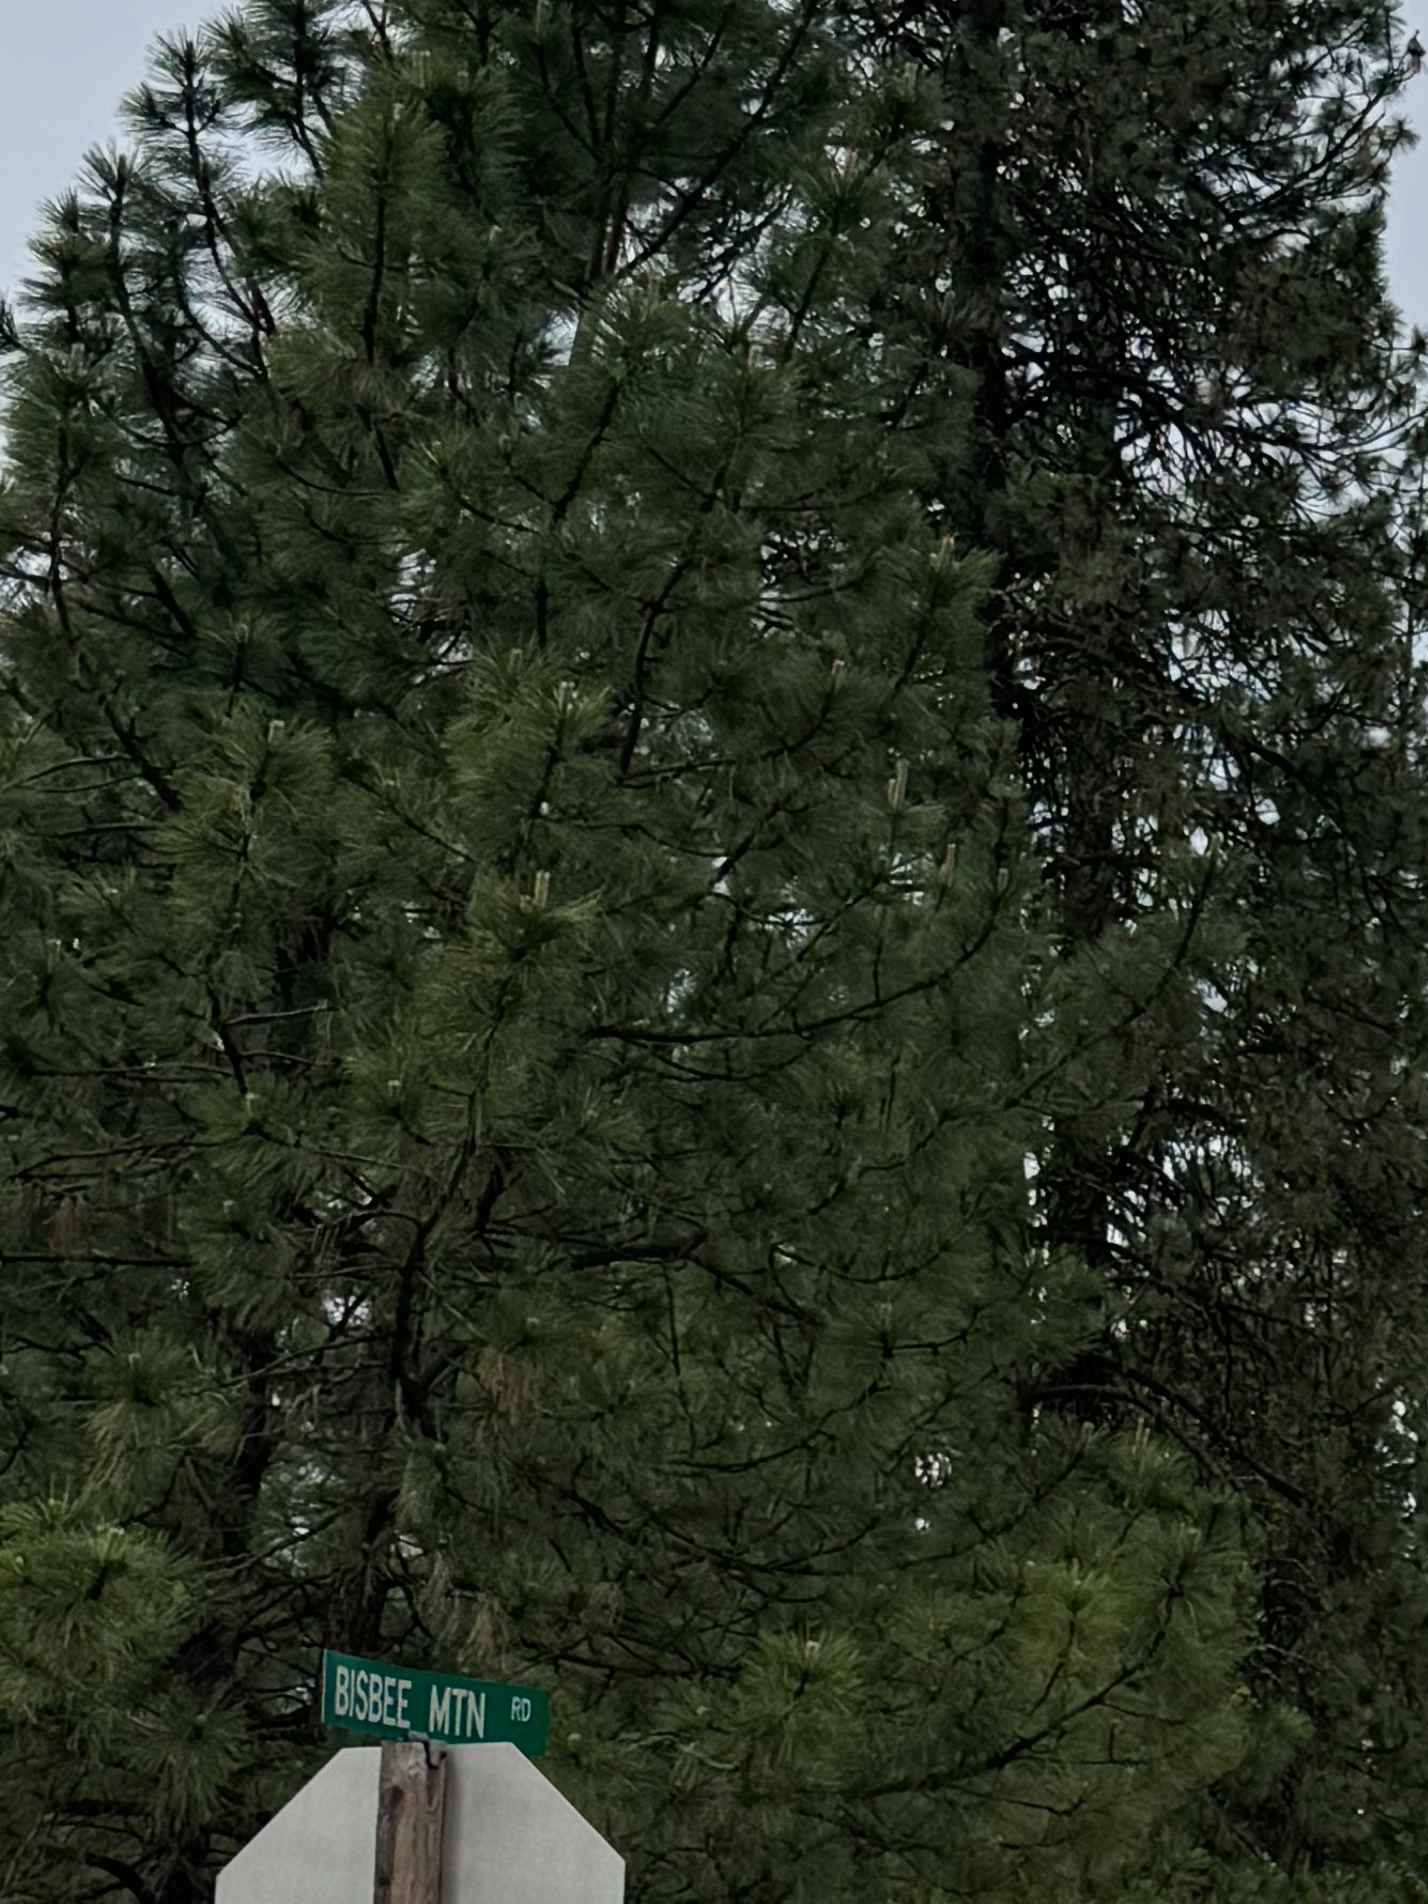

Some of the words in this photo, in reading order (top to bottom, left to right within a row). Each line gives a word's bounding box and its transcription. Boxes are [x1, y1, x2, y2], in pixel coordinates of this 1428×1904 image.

[334, 1664, 412, 1729] BISBEE
[428, 1684, 486, 1739] MTN
[510, 1696, 532, 1722] RD
